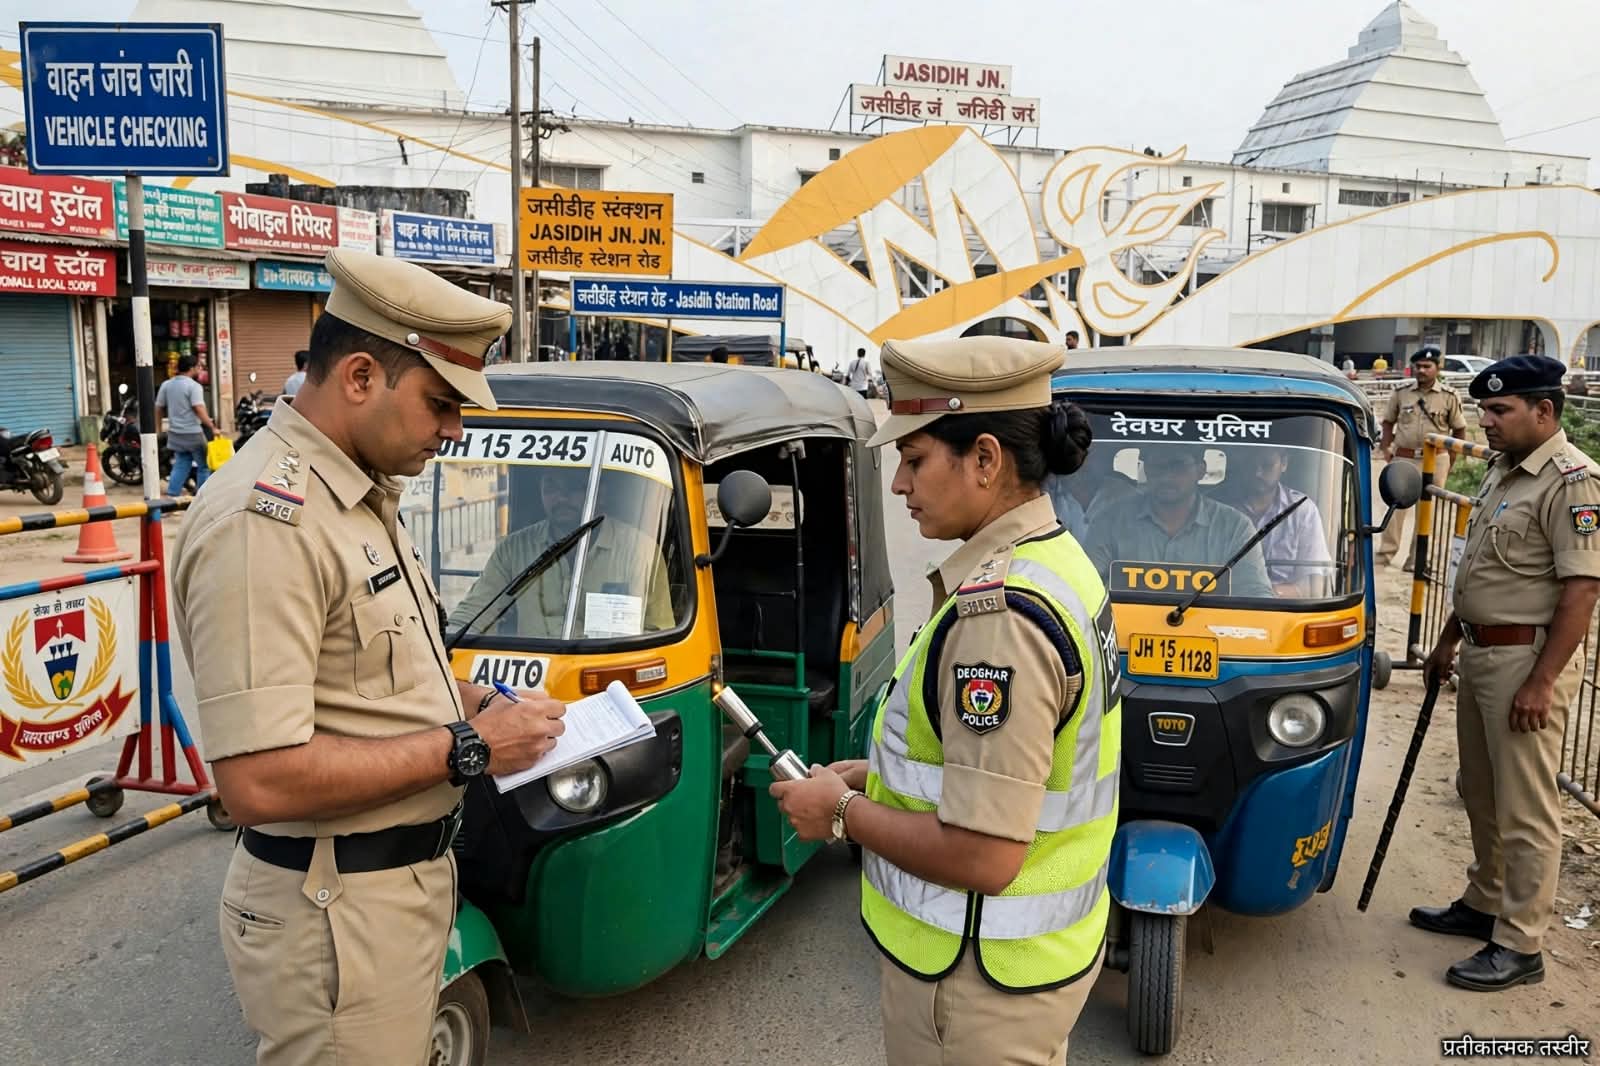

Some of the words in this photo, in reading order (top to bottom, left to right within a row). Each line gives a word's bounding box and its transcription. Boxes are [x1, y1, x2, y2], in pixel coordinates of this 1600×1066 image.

[45, 62, 95, 102] वाहन
[100, 49, 143, 97] जांच
[148, 48, 193, 98] जारी
[893, 61, 969, 87] JASIDIH
[976, 69, 1005, 89] JN.
[860, 90, 922, 118] जसीडीह
[44, 115, 117, 147] VEHICLE
[119, 115, 208, 148] CHECKING
[0, 184, 43, 214] चाय
[528, 193, 595, 219] जसीडीह
[228, 197, 288, 238] मोबाइल
[291, 204, 332, 240] रिपेयर
[530, 223, 602, 243] JASIDIH
[1, 250, 47, 274] चाय
[53, 249, 106, 278] स्टॉल
[526, 245, 584, 268] जसीडीह
[589, 247, 632, 268] स्टेशन
[637, 249, 662, 269] रोड
[676, 290, 712, 309] Jasidih
[714, 291, 751, 311] Station
[753, 293, 778, 312] Road
[1110, 411, 1186, 436] देवघर
[1194, 413, 1273, 442] पुलिस
[481, 433, 512, 459] 15
[517, 434, 588, 462] 2345
[611, 443, 655, 468] AUTO
[1122, 566, 1218, 593] TOTO
[1134, 638, 1154, 658] JH
[1159, 639, 1176, 659] 15
[1178, 647, 1212, 673] 1128
[1164, 660, 1173, 673] E
[472, 658, 543, 688] AUTO
[957, 667, 1009, 682] DEOGHAR
[961, 712, 1000, 726] POLICE
[1156, 718, 1186, 731] TOTO
